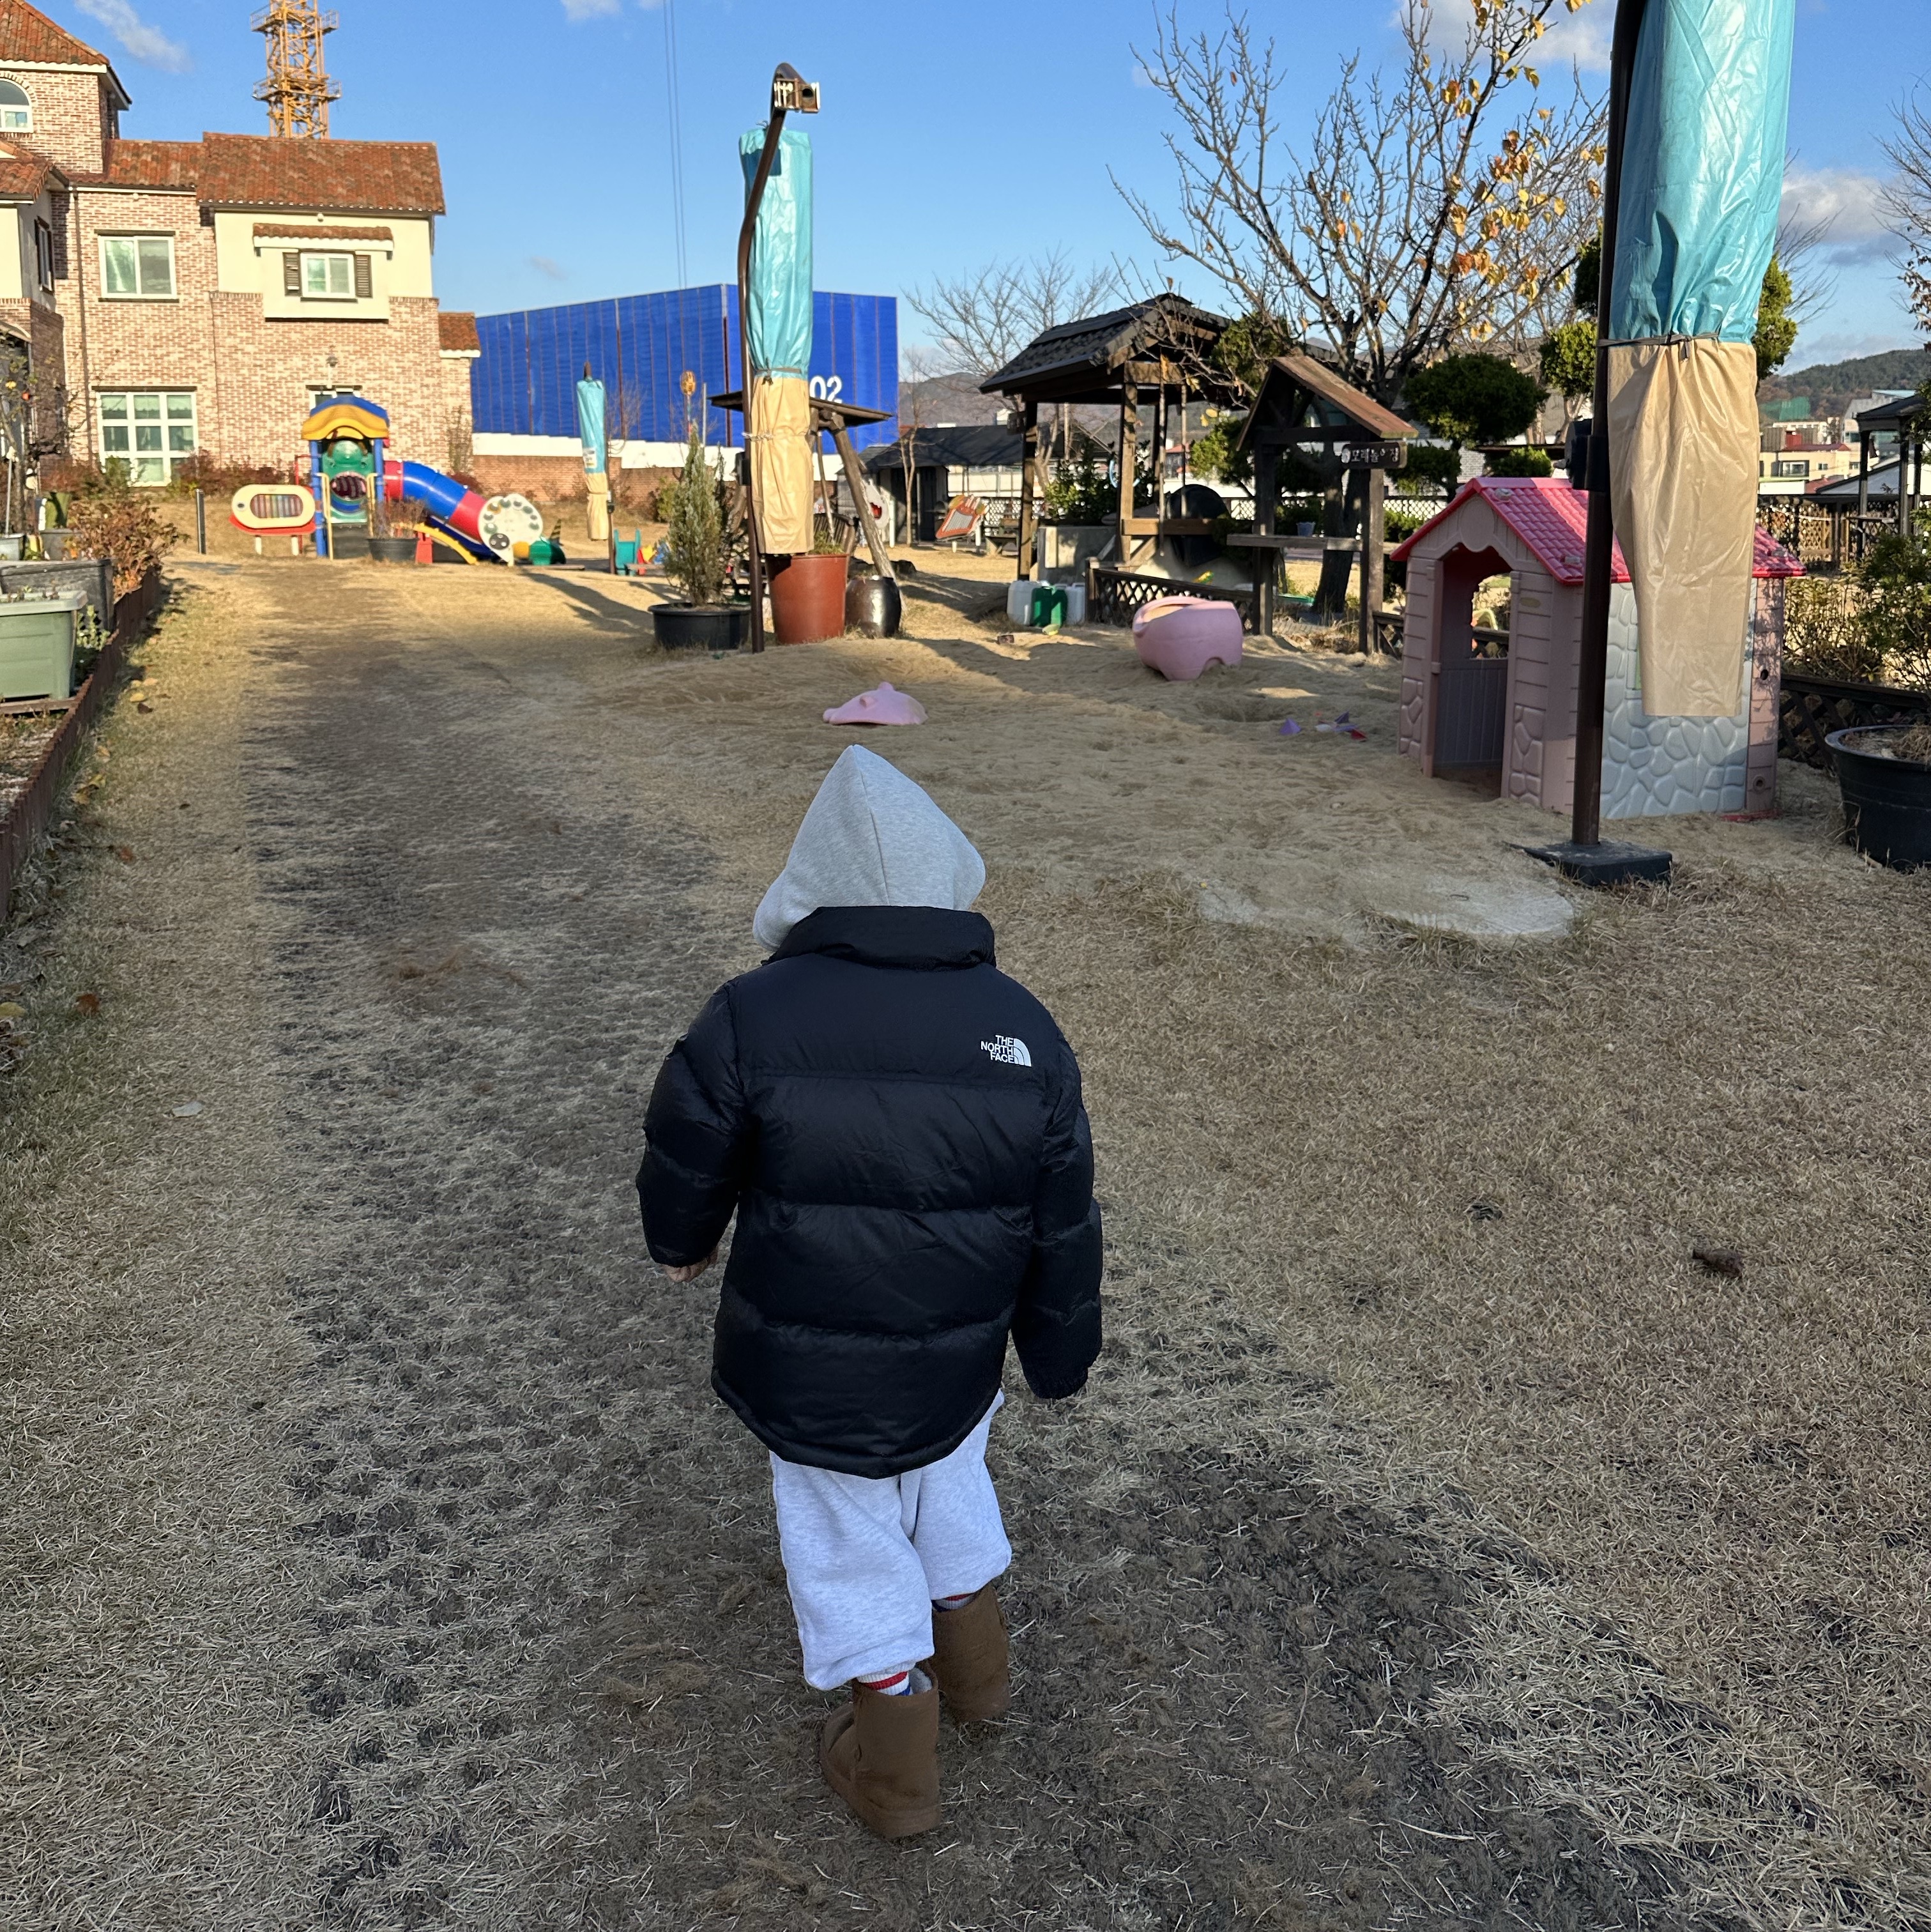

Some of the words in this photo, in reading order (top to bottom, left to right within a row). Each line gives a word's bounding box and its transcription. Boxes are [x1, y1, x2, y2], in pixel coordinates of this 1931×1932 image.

[809, 376, 843, 404] 02
[995, 1035, 1014, 1047] THE
[981, 1041, 1013, 1056] NORTH
[990, 1052, 1014, 1064] FACE
